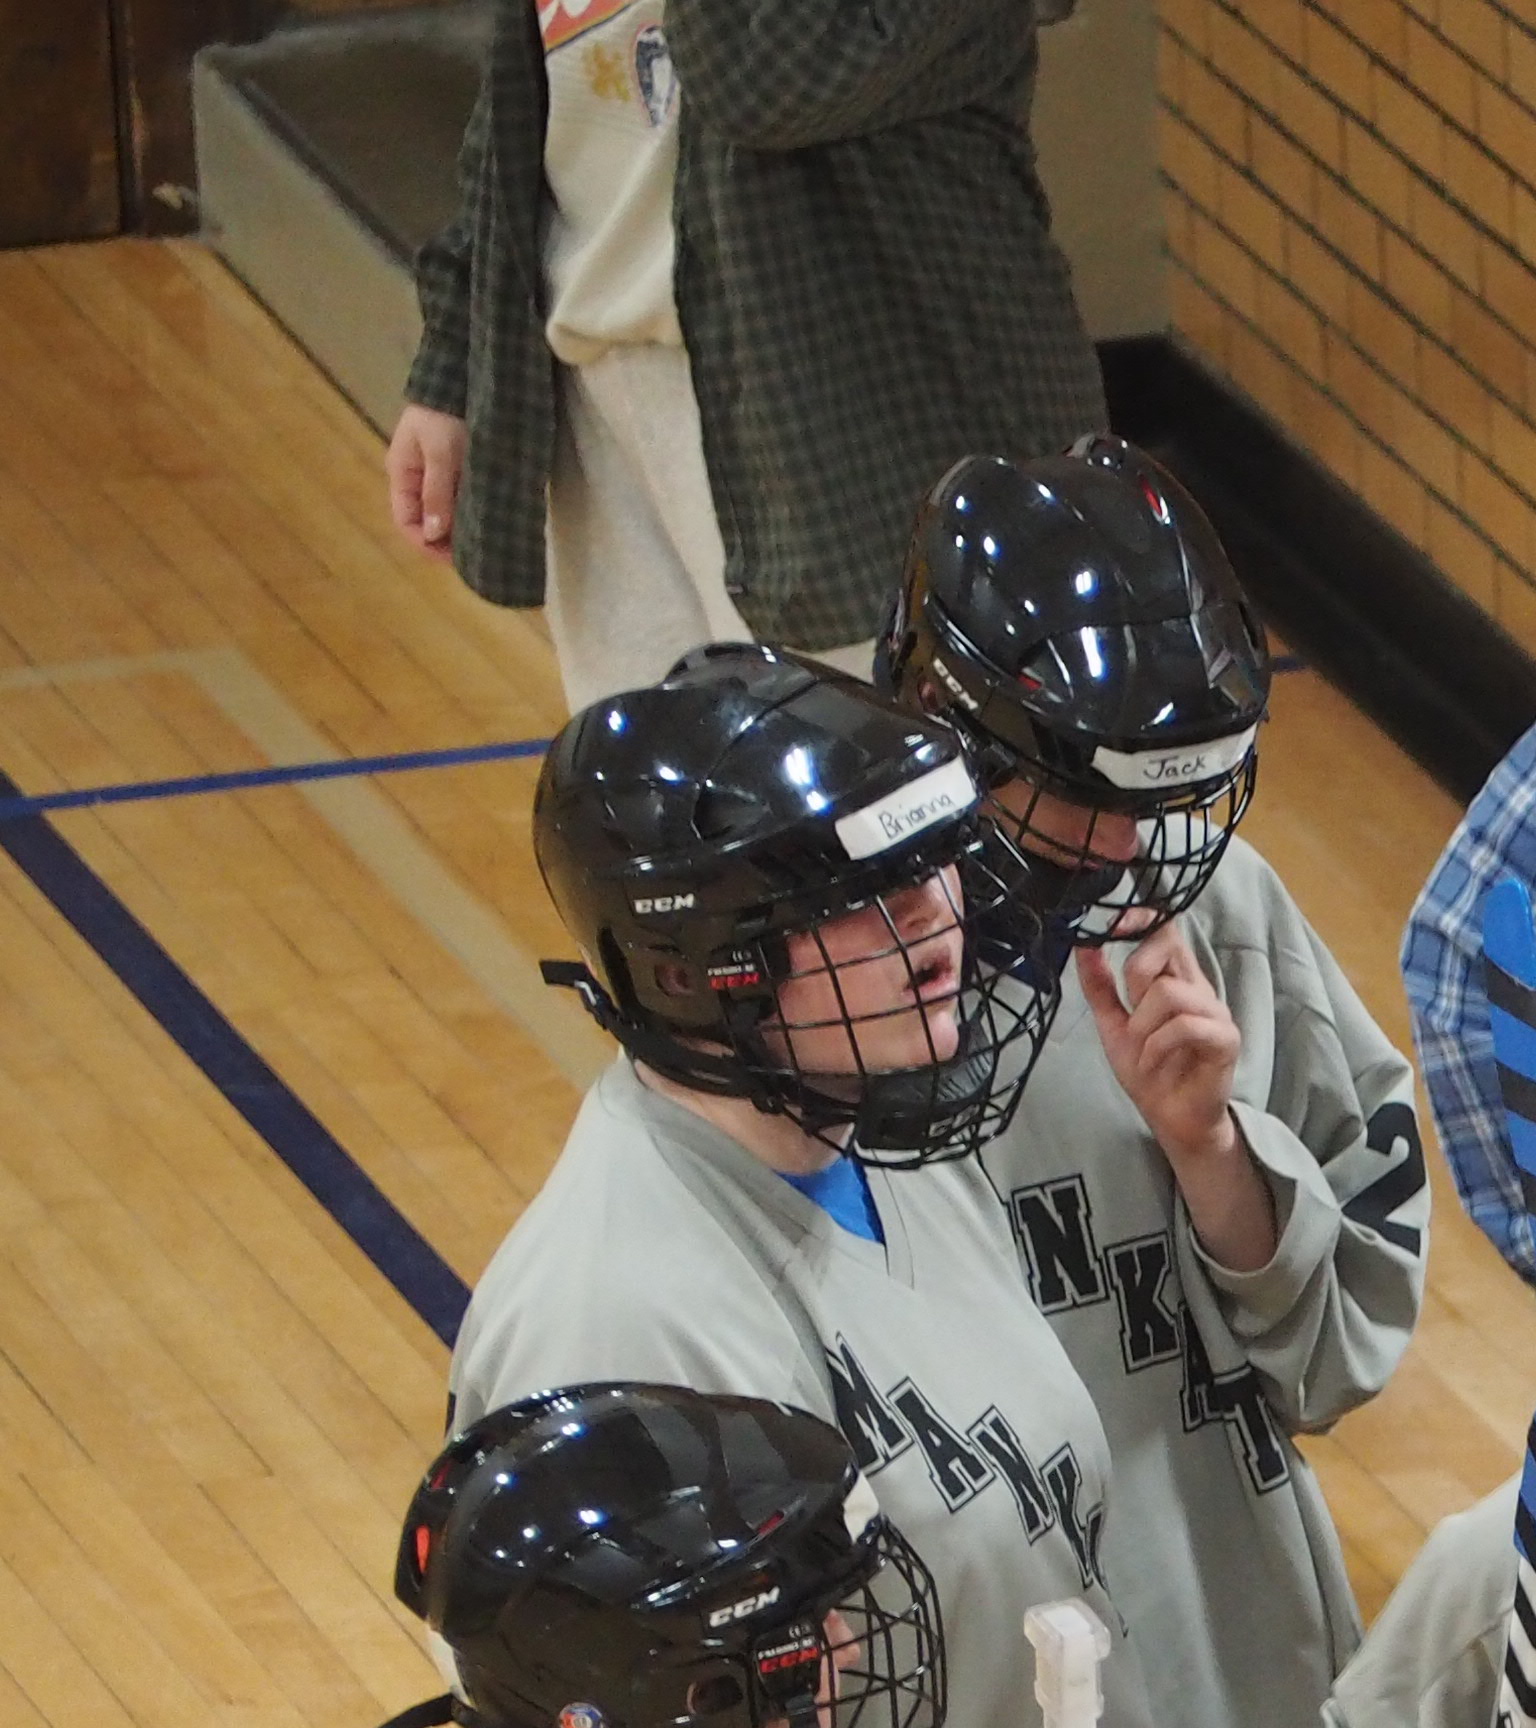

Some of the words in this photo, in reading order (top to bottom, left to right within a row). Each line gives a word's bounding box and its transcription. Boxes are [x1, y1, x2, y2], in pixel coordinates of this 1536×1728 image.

[1142, 754, 1206, 780] Jack
[878, 792, 956, 841] Brianna
[634, 893, 695, 914] CCM
[709, 1587, 781, 1628] CCM
